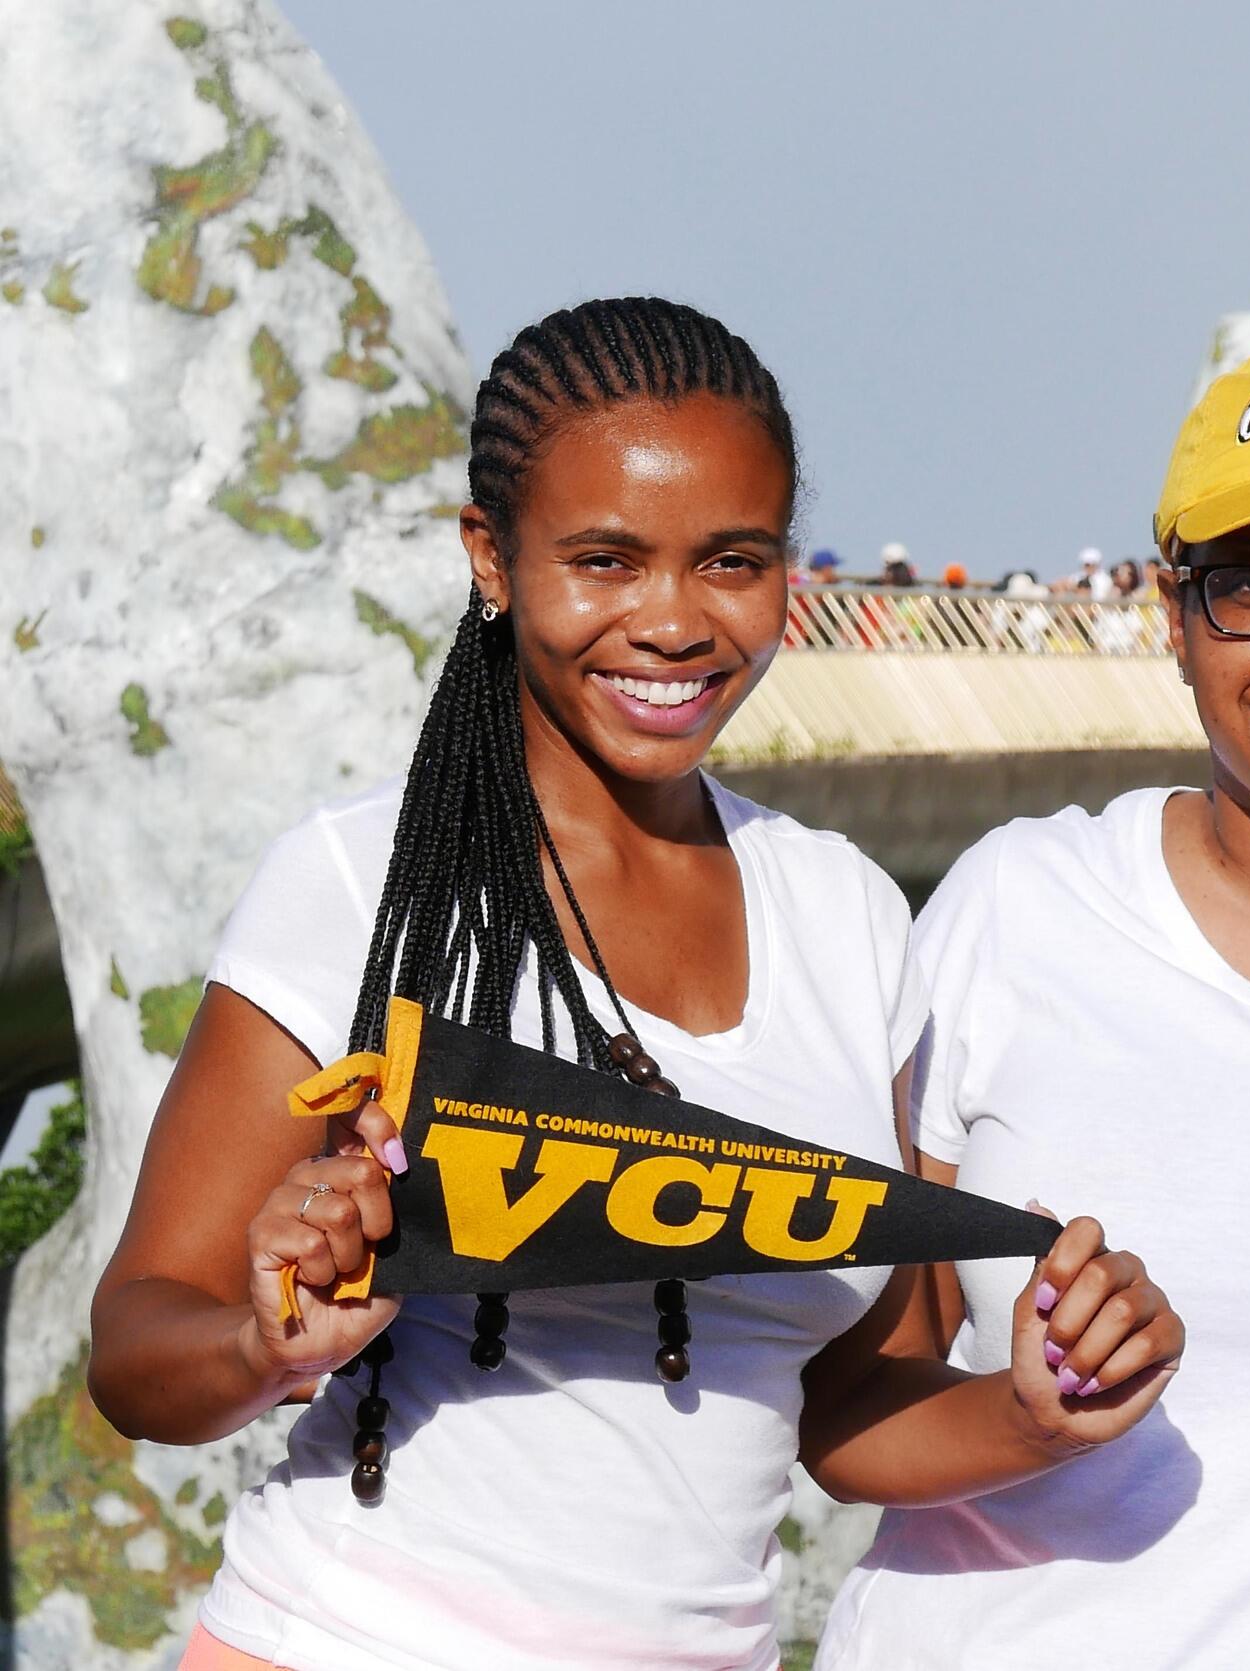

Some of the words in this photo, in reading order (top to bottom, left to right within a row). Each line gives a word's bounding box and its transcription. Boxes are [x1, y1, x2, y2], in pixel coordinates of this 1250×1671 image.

[433, 1097, 528, 1126] VIRGINIA
[536, 1114, 715, 1153] COMMONWEALTH
[722, 1142, 847, 1170] UNIVERSITY
[422, 1123, 888, 1262] VCU
